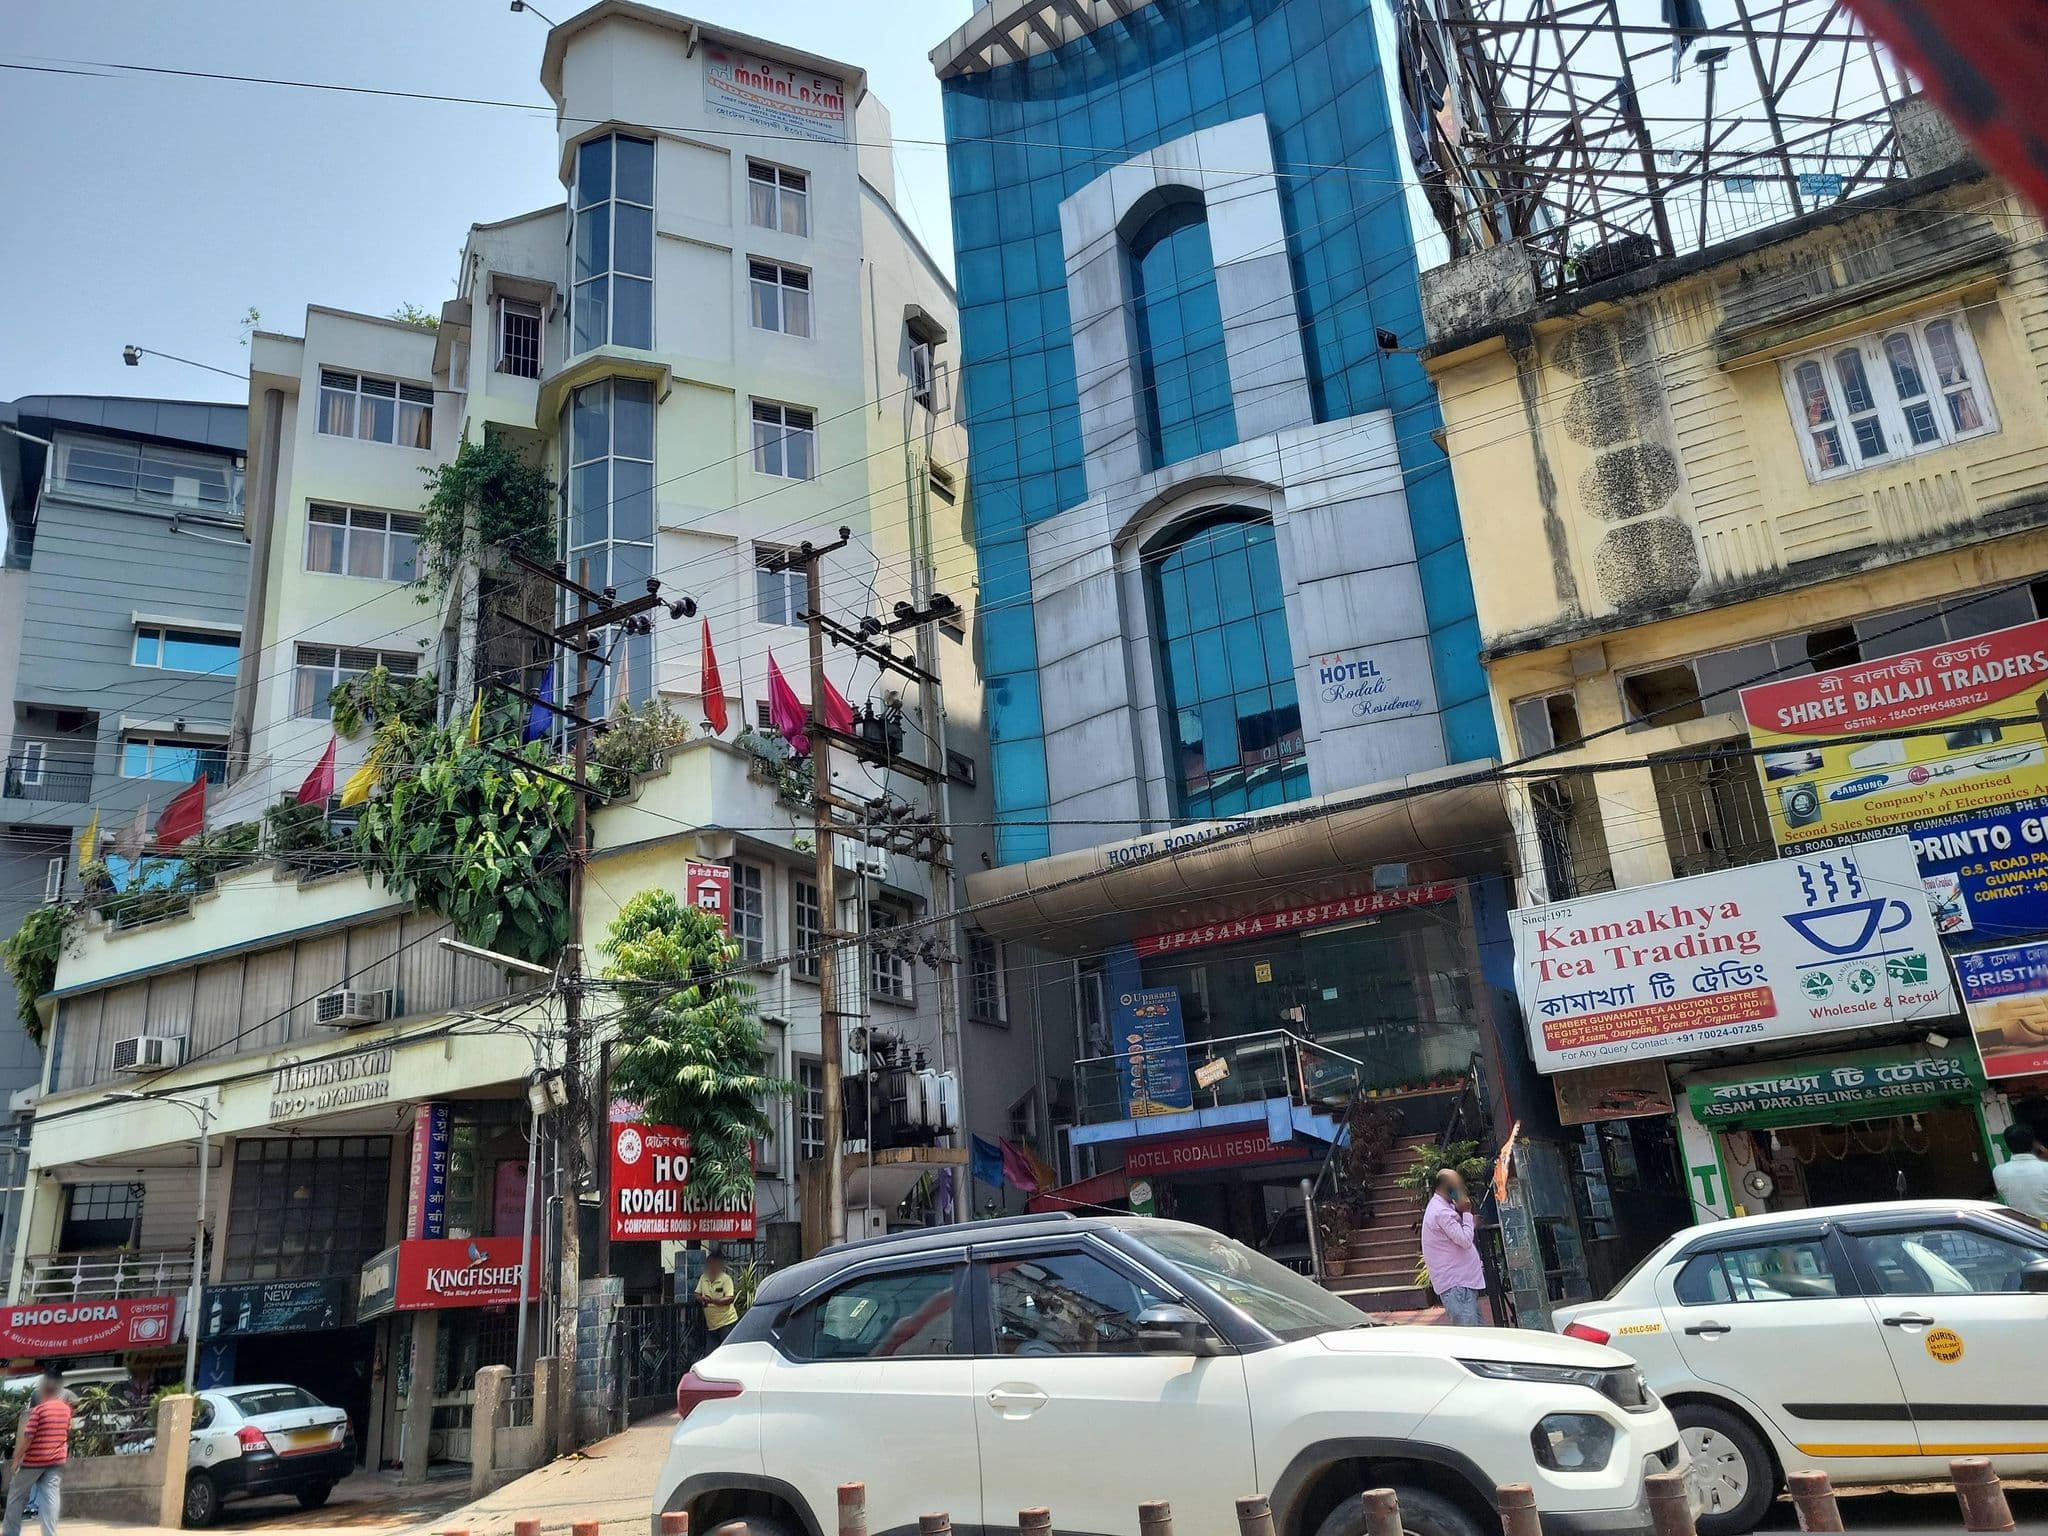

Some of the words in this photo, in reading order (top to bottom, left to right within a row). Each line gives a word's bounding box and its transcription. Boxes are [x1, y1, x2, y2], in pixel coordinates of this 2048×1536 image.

[1319, 660, 1381, 685] HOTEL
[1322, 677, 1388, 703] Rodali
[1776, 694, 1849, 728] SHREE
[1852, 675, 1935, 718] BALAJI
[1937, 650, 2048, 692] TRADERS
[1352, 697, 1423, 718] Residency
[1836, 779, 1884, 797] SAMSUNG
[1864, 790, 1937, 812] Company's
[1939, 774, 2012, 798] Authorised
[1785, 825, 1829, 842] Second
[1831, 819, 1863, 834] Sales
[1865, 804, 1935, 827] Showroom
[1938, 798, 1952, 811] of
[1956, 788, 2025, 811] Electronics
[1913, 812, 1969, 833] GUWAHATI
[1107, 841, 1156, 865] HOTEL
[1909, 824, 2012, 864] PRINTO
[1961, 863, 1988, 877] G.S.
[1990, 855, 2029, 872] ROAD
[1974, 884, 2025, 903] CONTACT
[1158, 915, 1264, 951] UPASANA
[1274, 884, 1440, 930] RESTAURANT
[1535, 899, 1742, 953] Kamakhya
[1530, 955, 1595, 983] Tea
[1604, 929, 1762, 971] Trading
[1133, 990, 1177, 1003] Upasana
[1649, 971, 1676, 1000] টি
[1545, 1018, 1588, 1033] MEMBER
[1589, 1009, 1643, 1026] GUWAHATI
[1645, 1006, 1667, 1018] TEA
[1667, 996, 1714, 1014] AUCTION
[1715, 990, 1760, 1006] CENTRE
[1808, 999, 1878, 1020] Wholesale
[1883, 996, 1894, 1008] &
[1897, 989, 1940, 1006] Retail
[1546, 1023, 1613, 1041] REGISTERED
[1615, 1016, 1654, 1031] UNDER
[1655, 1013, 1678, 1025] TEA
[1679, 1006, 1720, 1021] BOARD
[1721, 1002, 1738, 1014] OF
[1559, 1036, 1579, 1047] For
[1662, 1018, 1689, 1032] Green
[1703, 1011, 1742, 1028] Organic
[1741, 1007, 1761, 1018] Tea
[1561, 1051, 1578, 1062] For
[1578, 1047, 1598, 1063] Any
[1599, 1043, 1629, 1060] Query
[1631, 1036, 1669, 1051] Contact
[1676, 1031, 1695, 1044] +91
[1697, 1022, 1765, 1041] 70024-07285
[1702, 1100, 1756, 1117] ASSAM
[1761, 1088, 1862, 1111] DARJEELING
[1878, 1080, 1936, 1098] GREEN
[1940, 1076, 1974, 1091] TEA
[1128, 1150, 1171, 1169] HOTEL
[1173, 1142, 1223, 1164] RODALI
[620, 1187, 677, 1215] RODALI
[624, 1218, 669, 1233] COMFORTABLE
[669, 1218, 692, 1233] ROOMS
[699, 1218, 735, 1233] RESTAURANT
[740, 1217, 753, 1232] BAR
[264, 1280, 321, 1292] INTRODUCING
[426, 1264, 522, 1294] KINGFISHER
[263, 1290, 293, 1303] NEW
[11, 1305, 119, 1328] BHOGJORA
[10, 1334, 69, 1348] MULTICUISINE
[72, 1319, 126, 1347] RESTAURANT
[1927, 1331, 1957, 1345] TOURIST
